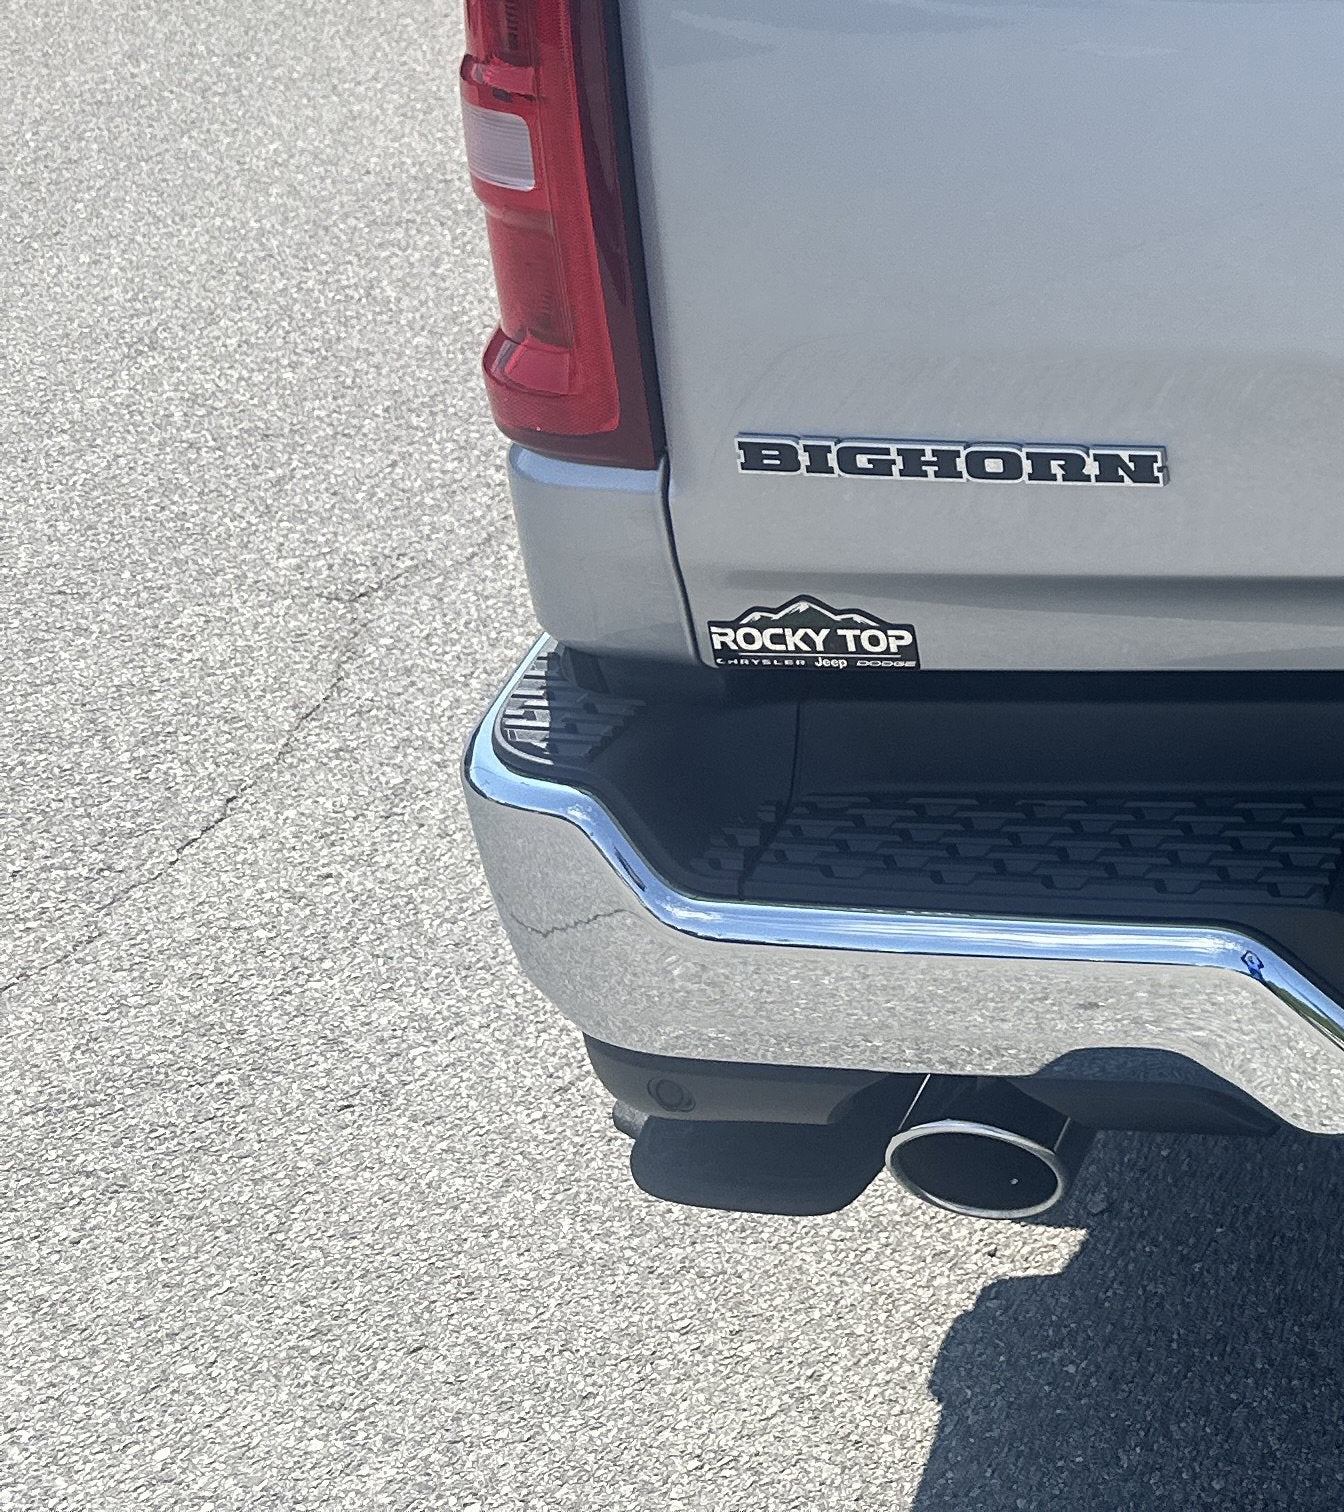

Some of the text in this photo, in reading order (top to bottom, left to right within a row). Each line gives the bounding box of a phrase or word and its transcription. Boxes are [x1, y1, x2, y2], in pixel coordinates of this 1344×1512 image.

[734, 433, 1169, 486] BIGHORN
[710, 625, 913, 653] ROCKY TOP
[716, 656, 917, 669] CHRYSLER Jeep DODGE
